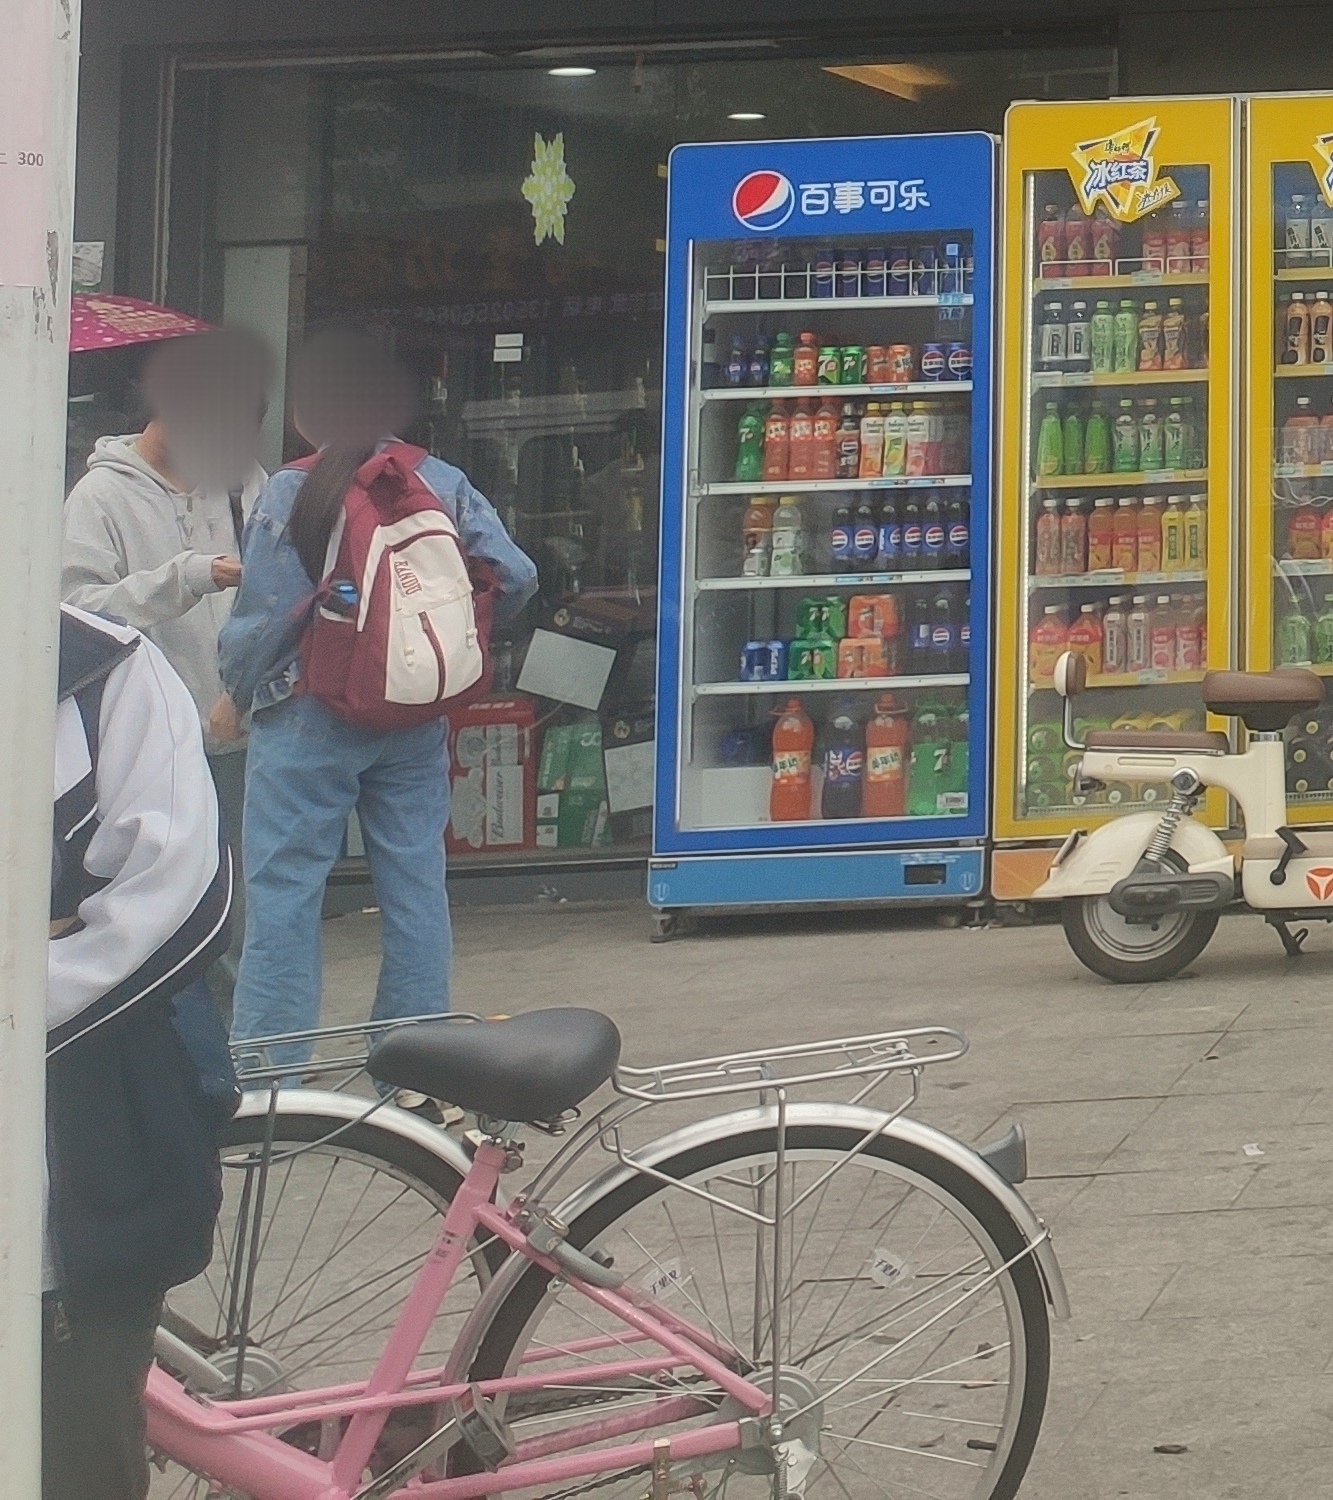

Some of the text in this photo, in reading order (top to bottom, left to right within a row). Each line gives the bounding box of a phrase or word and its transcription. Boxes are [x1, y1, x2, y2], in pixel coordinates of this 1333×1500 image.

[17, 152, 44, 167] 300
[1085, 158, 1149, 199] 冰红茶
[799, 179, 930, 215] 百事可乐
